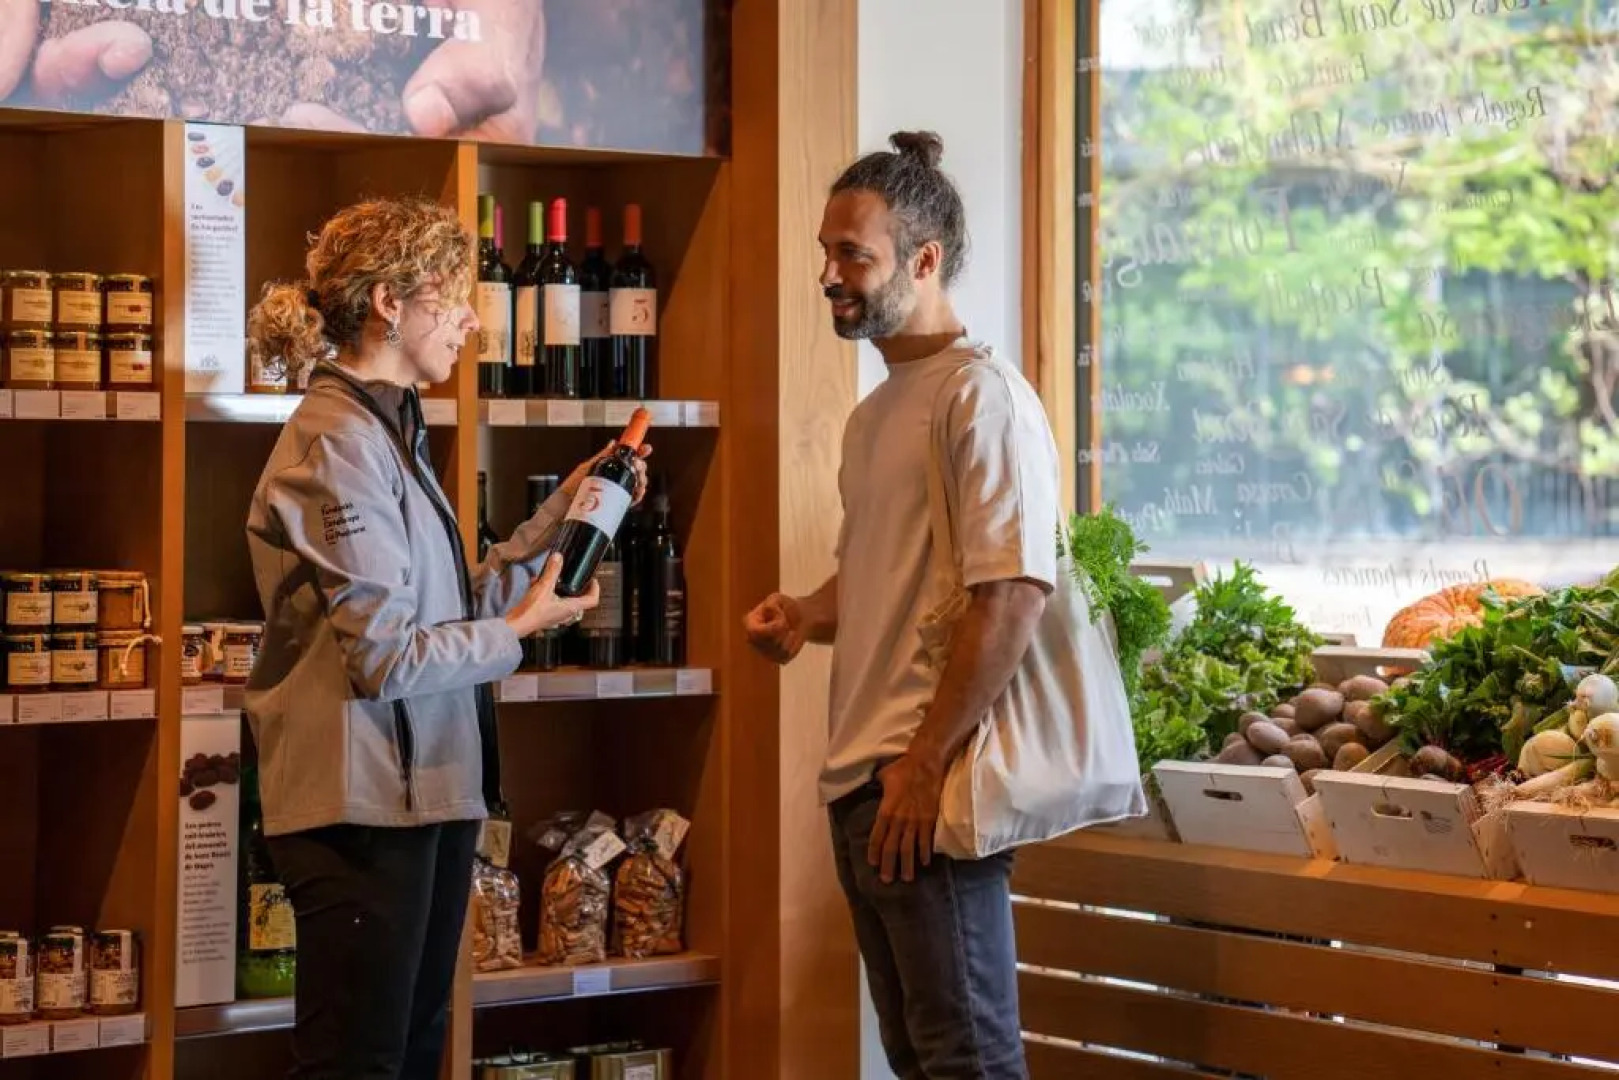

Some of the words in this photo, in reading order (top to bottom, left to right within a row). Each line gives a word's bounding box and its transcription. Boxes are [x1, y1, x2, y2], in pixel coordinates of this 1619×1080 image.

[203, 0, 270, 22] de
[285, 0, 335, 28] la
[352, 0, 482, 42] terra
[632, 298, 650, 324] 5
[578, 486, 603, 513] 5
